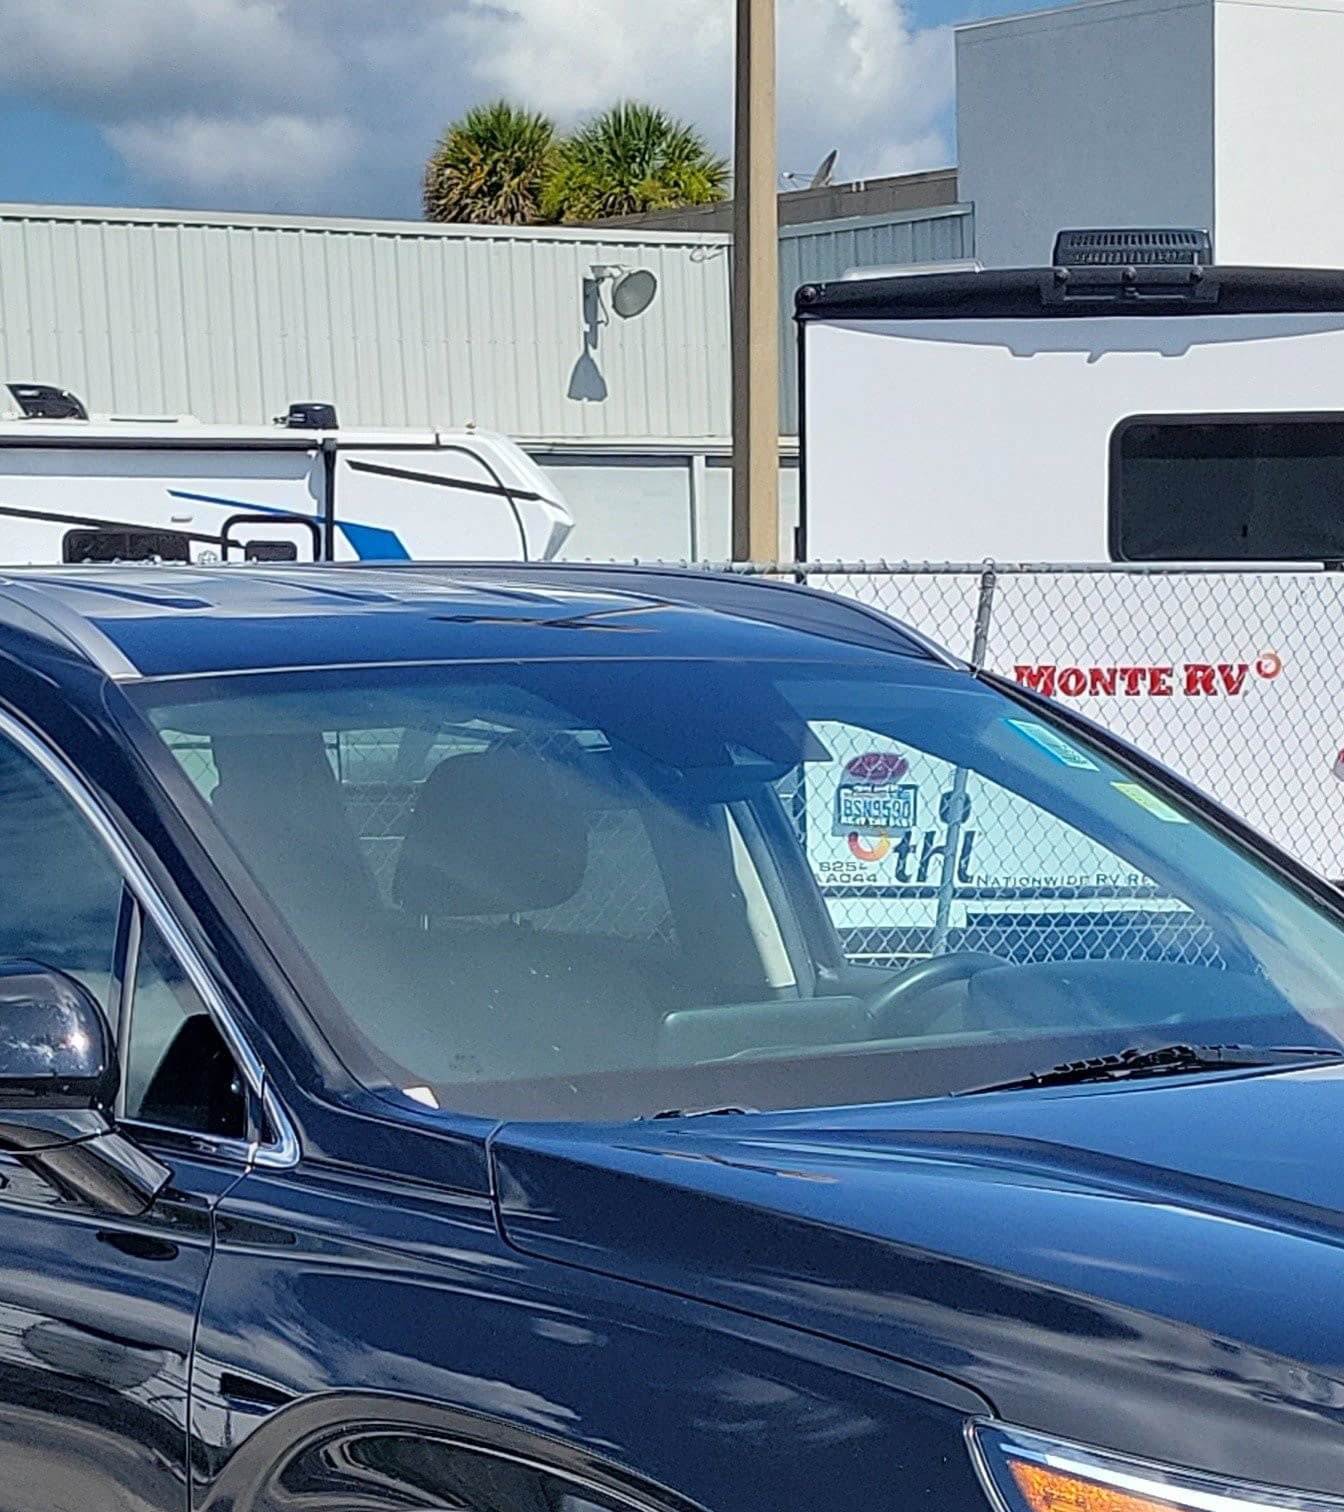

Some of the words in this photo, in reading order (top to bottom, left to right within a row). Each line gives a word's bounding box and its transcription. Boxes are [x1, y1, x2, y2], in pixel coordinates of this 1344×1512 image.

[1014, 665, 1174, 699] MONTE
[1183, 663, 1249, 698] RV
[1096, 873, 1120, 885] RV
